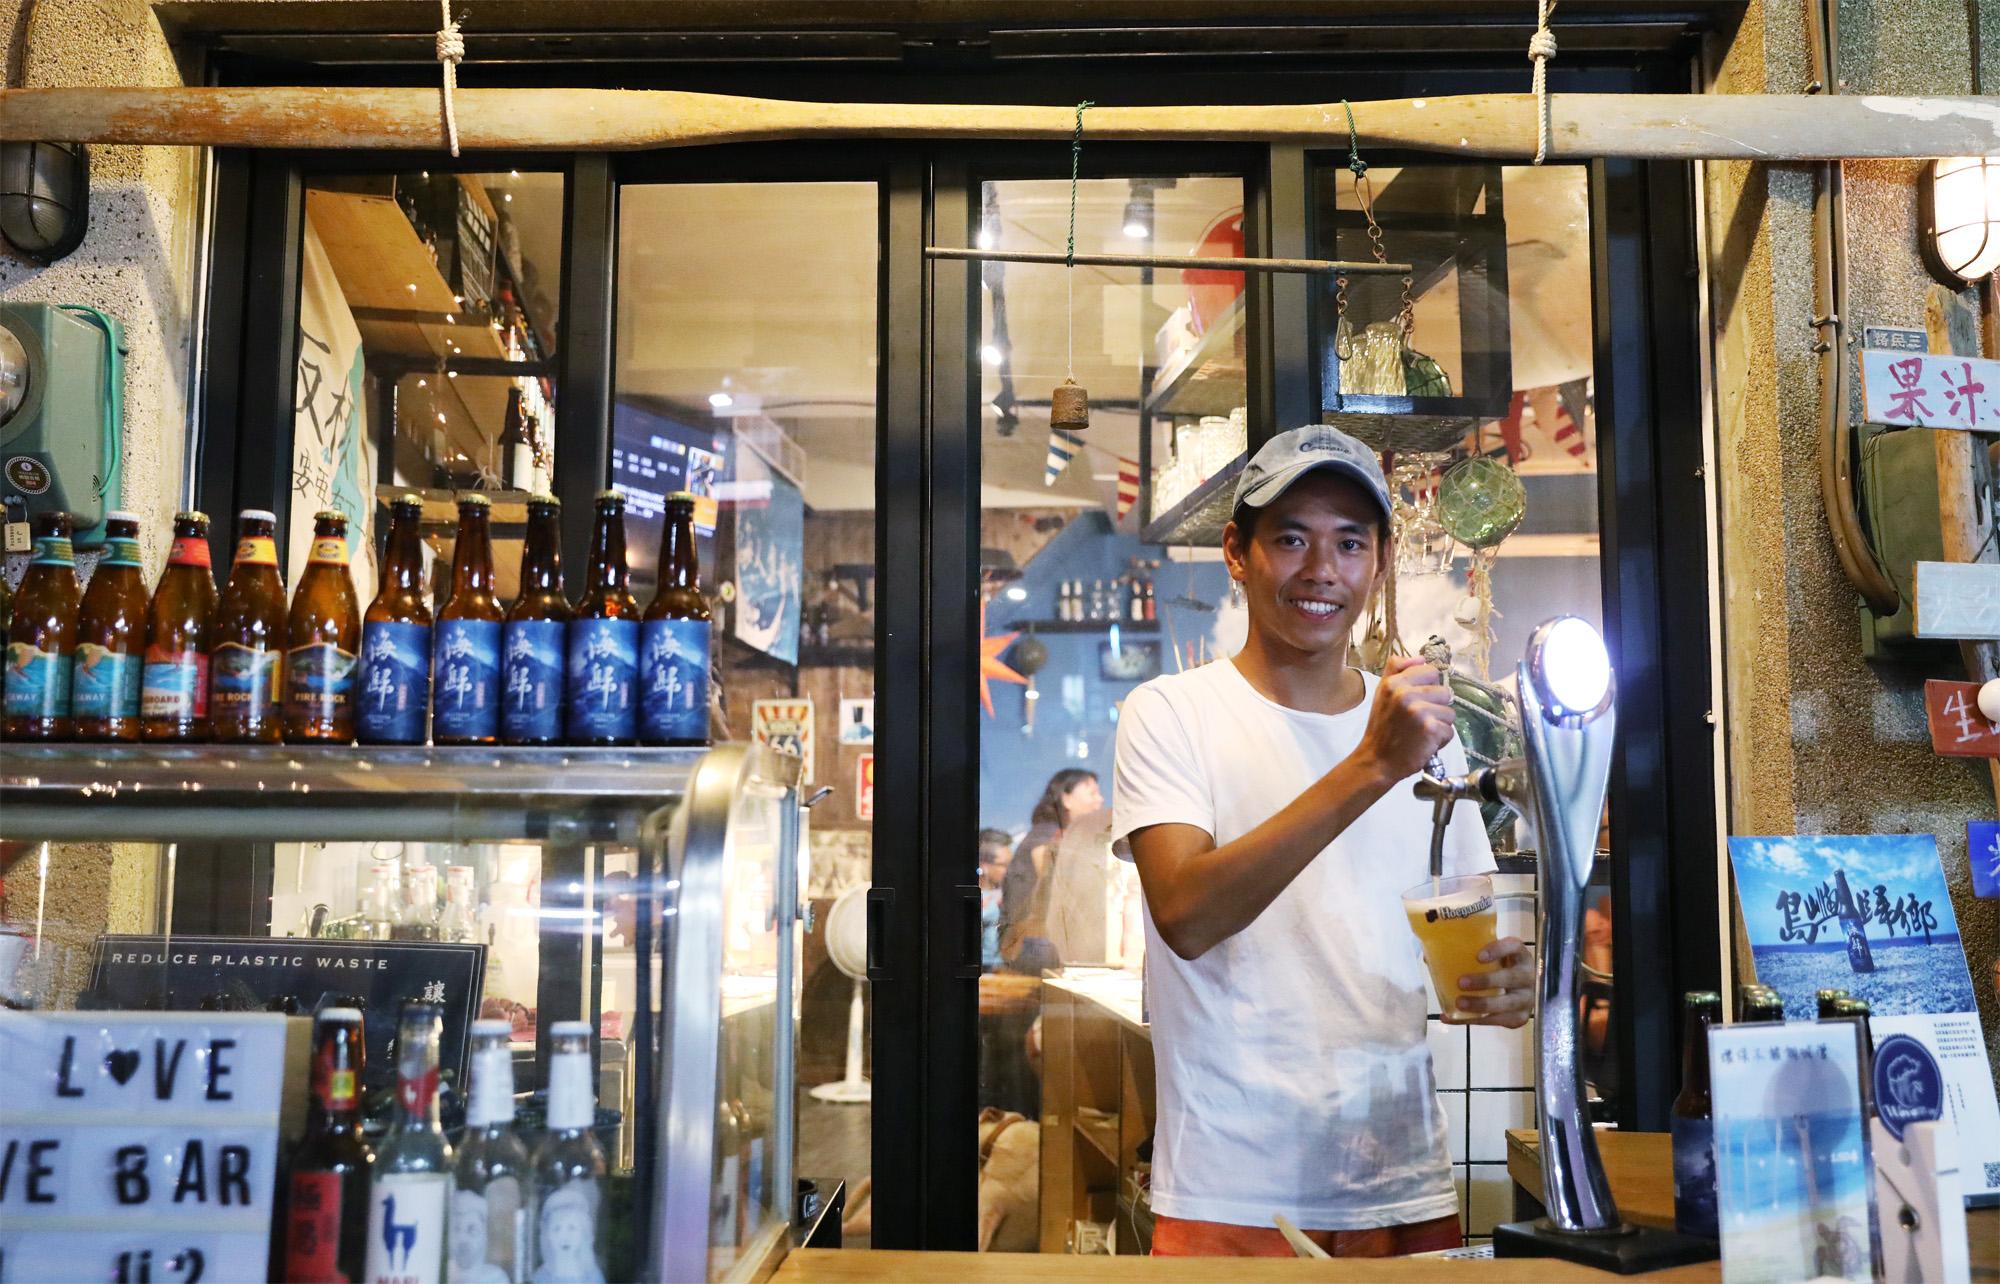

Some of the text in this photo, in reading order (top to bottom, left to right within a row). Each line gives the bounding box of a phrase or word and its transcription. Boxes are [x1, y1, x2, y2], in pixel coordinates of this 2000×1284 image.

[111, 953, 388, 970] REDUCE PLASTIC WASTE
[114, 1139, 252, 1206] BAR
